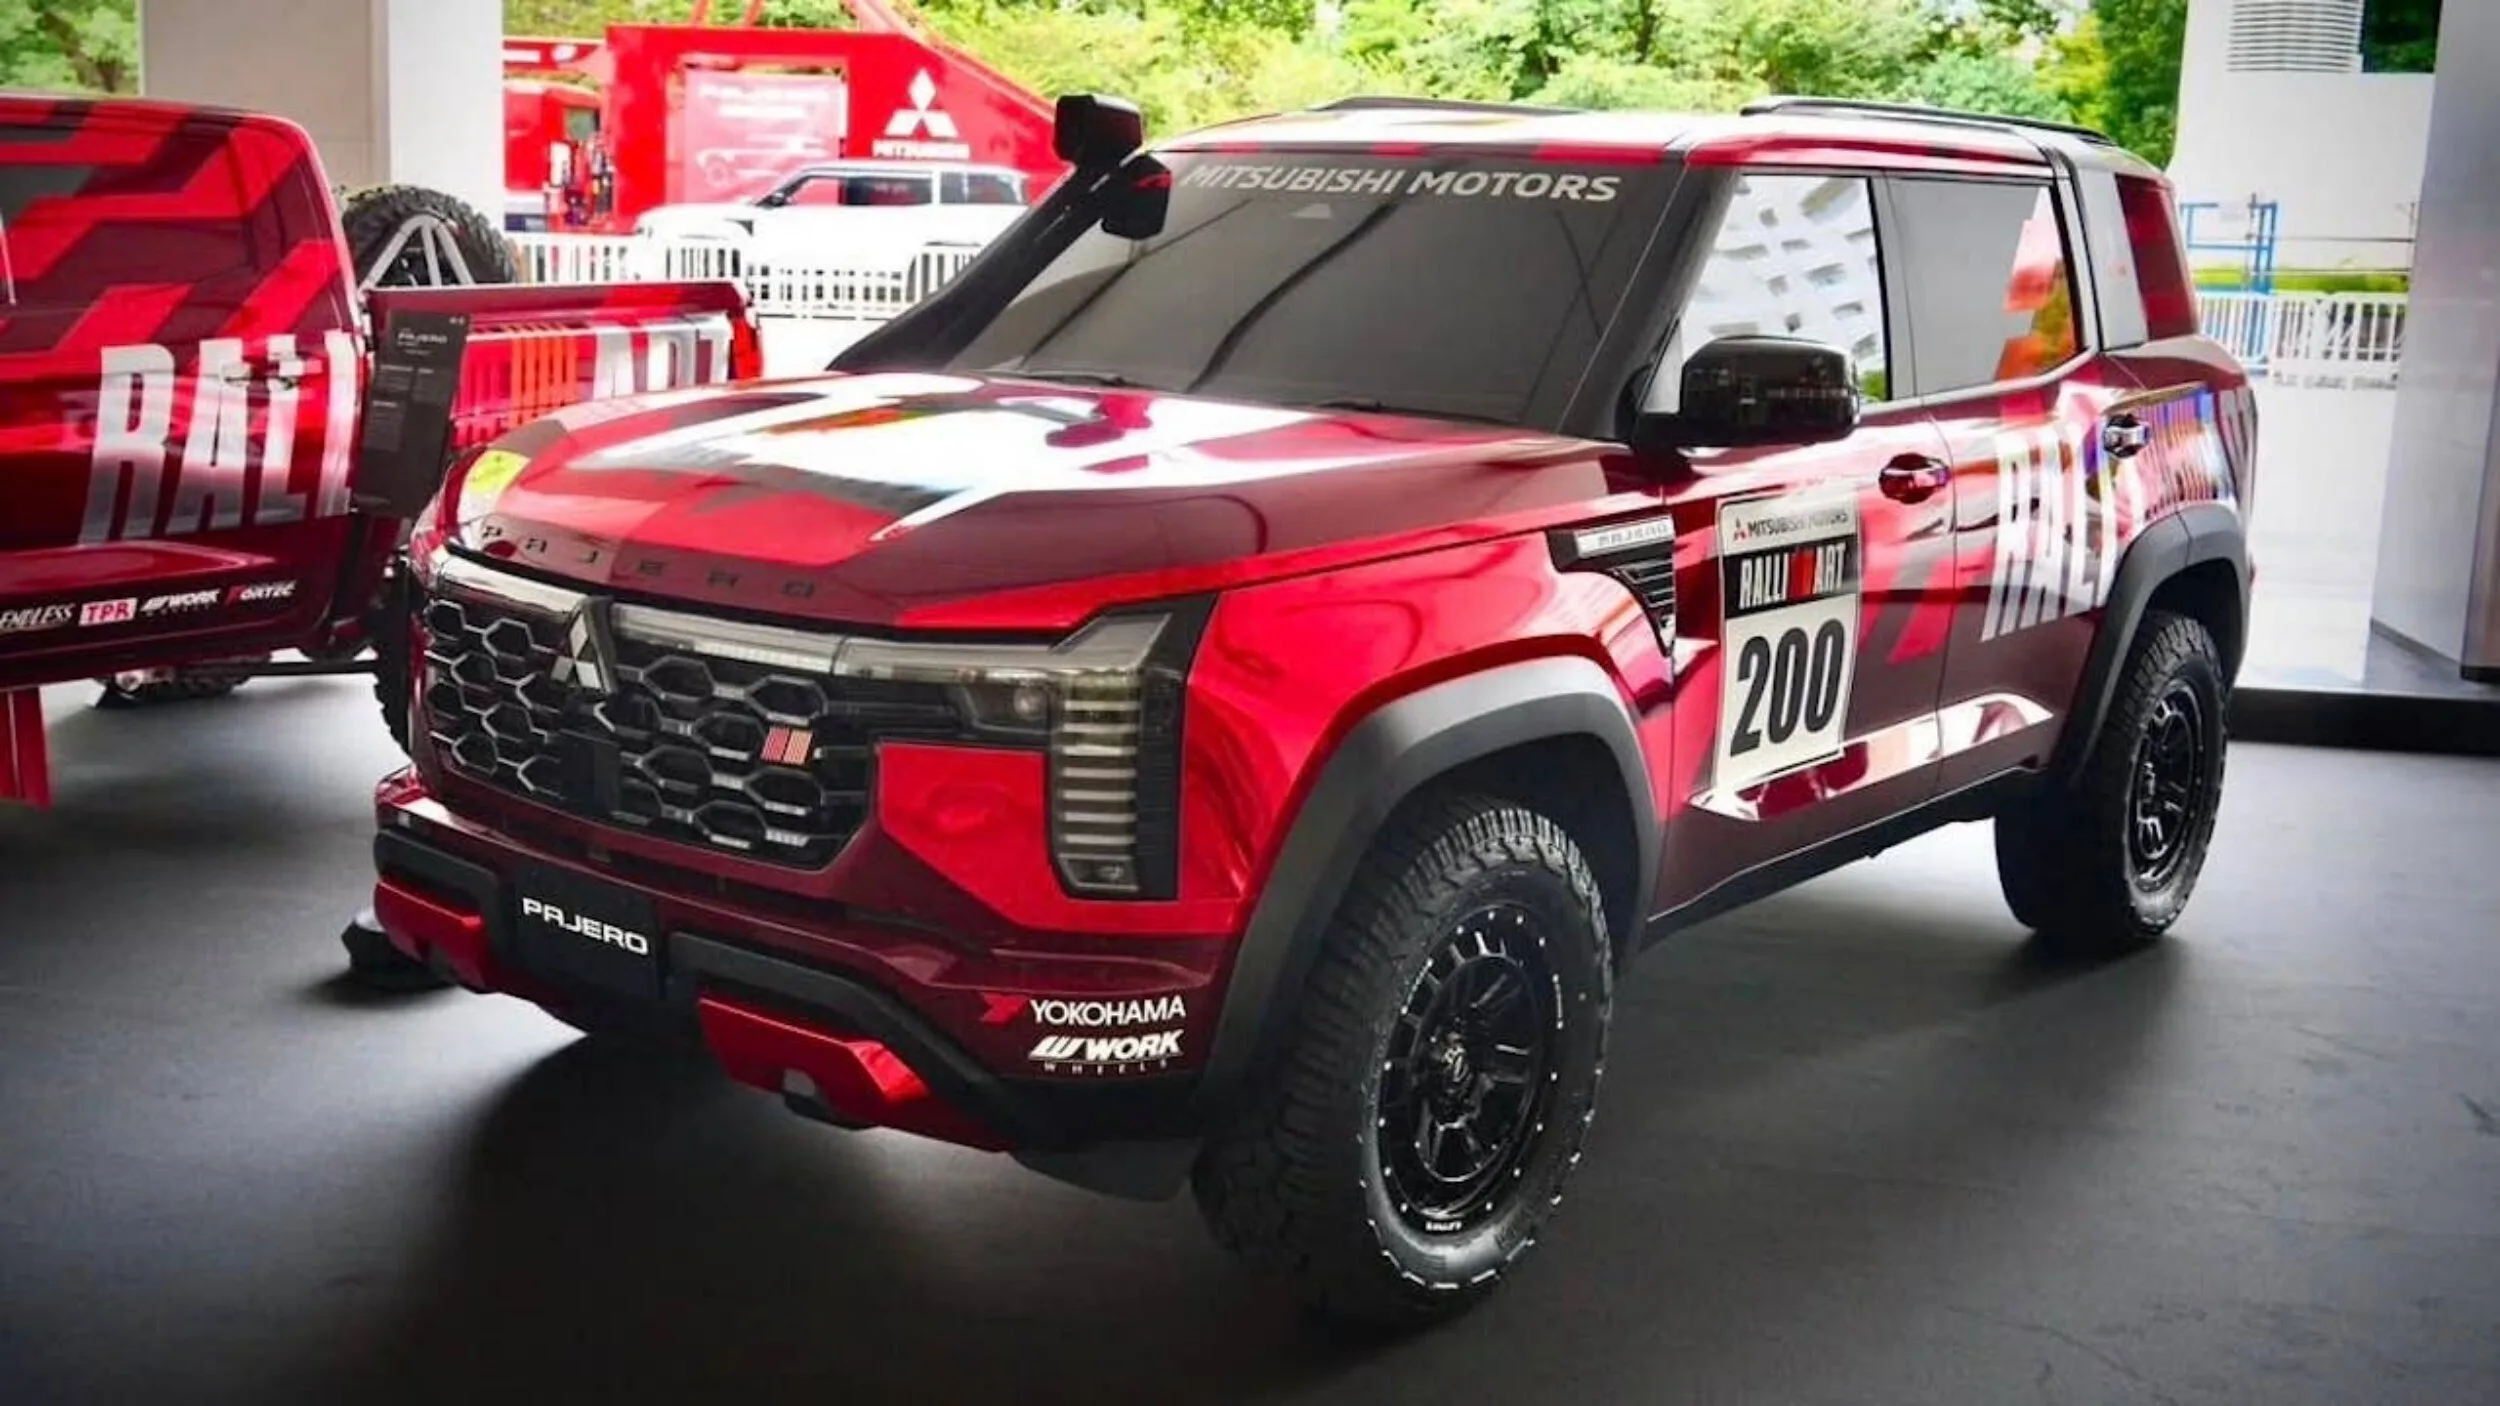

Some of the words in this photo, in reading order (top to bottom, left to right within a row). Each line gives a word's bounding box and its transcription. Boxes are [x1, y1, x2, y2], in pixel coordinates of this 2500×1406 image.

[1180, 163, 1404, 195] MITSUBISHI
[1406, 170, 1622, 202] MOTORS
[483, 525, 815, 597] PAJERO
[0, 604, 75, 631] ENDLESS
[86, 601, 132, 622] TPR
[1730, 618, 1845, 757] 200
[522, 896, 649, 956] PAJERO
[1029, 994, 1187, 1027] YOKOHAMA
[1084, 1028, 1185, 1061] WORK
[1043, 1058, 1168, 1075] WHEELS
